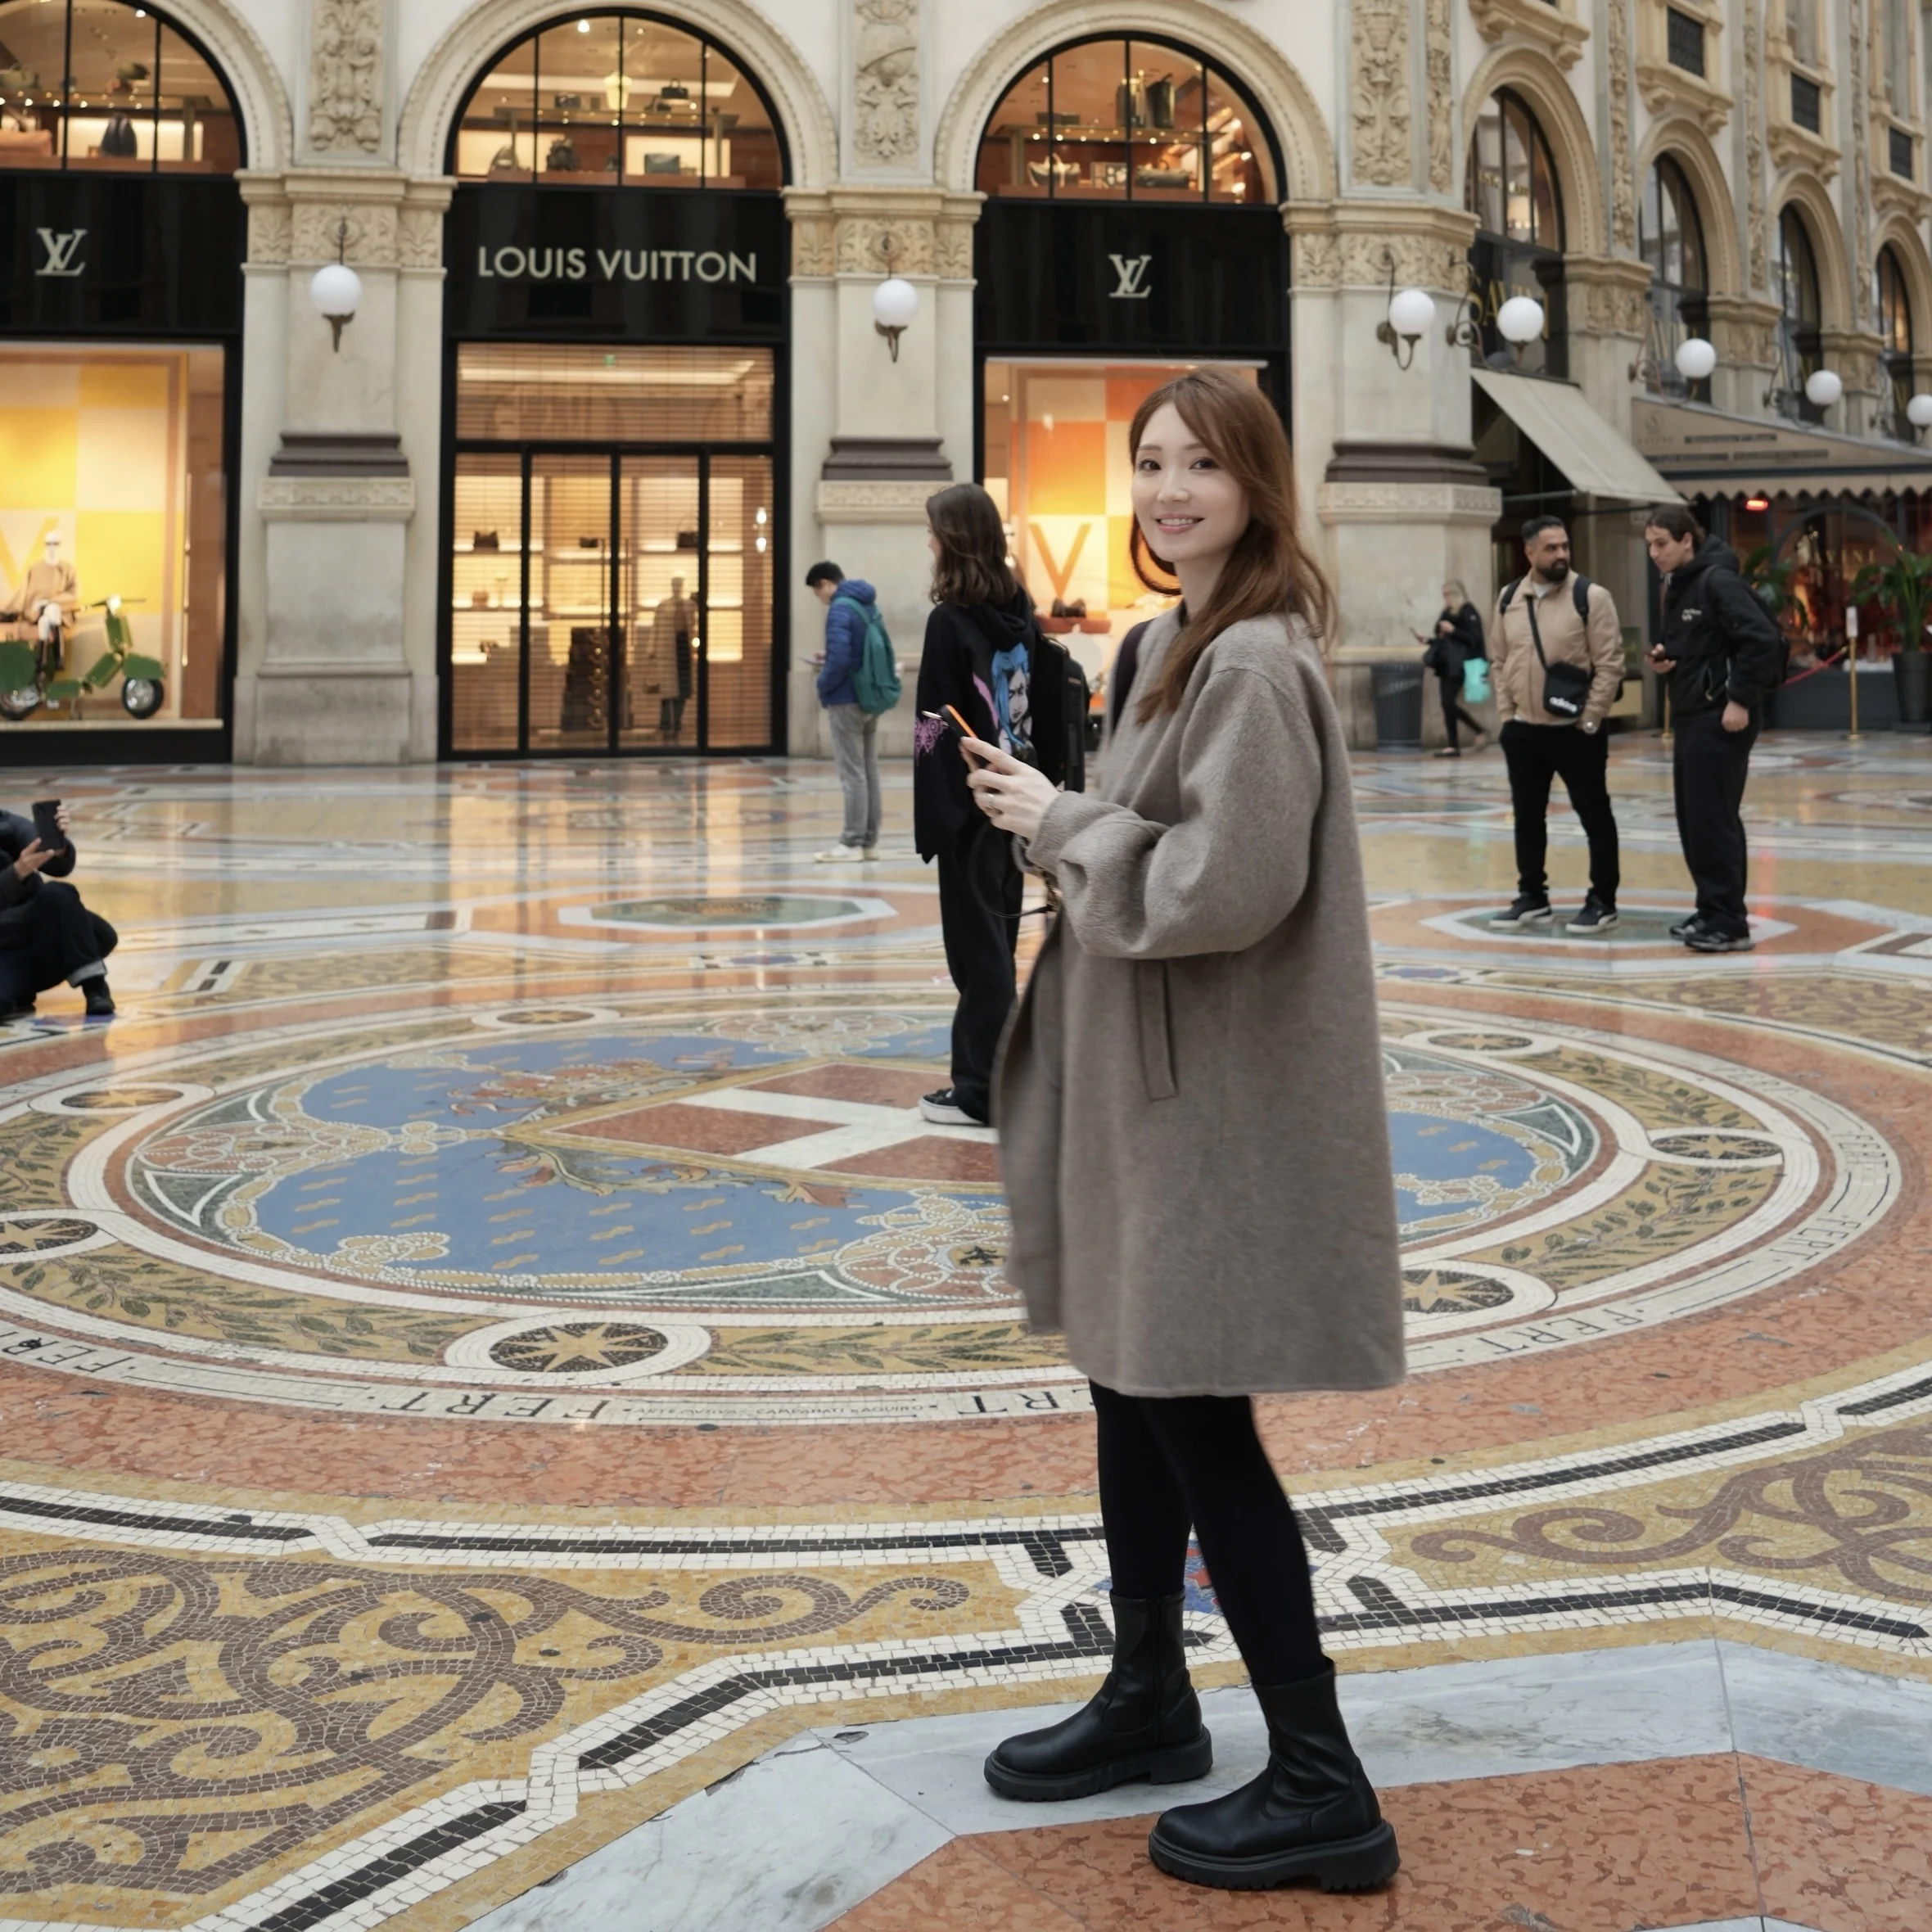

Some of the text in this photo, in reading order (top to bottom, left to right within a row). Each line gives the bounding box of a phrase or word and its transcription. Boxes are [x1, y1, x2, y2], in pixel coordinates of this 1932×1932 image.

[478, 246, 757, 282] LOUIS VUITTON
[1028, 522, 1093, 601] V
[1768, 1217, 1862, 1262] FERT
[1476, 1307, 1644, 1356] FERT
[380, 1391, 610, 1420] FERT
